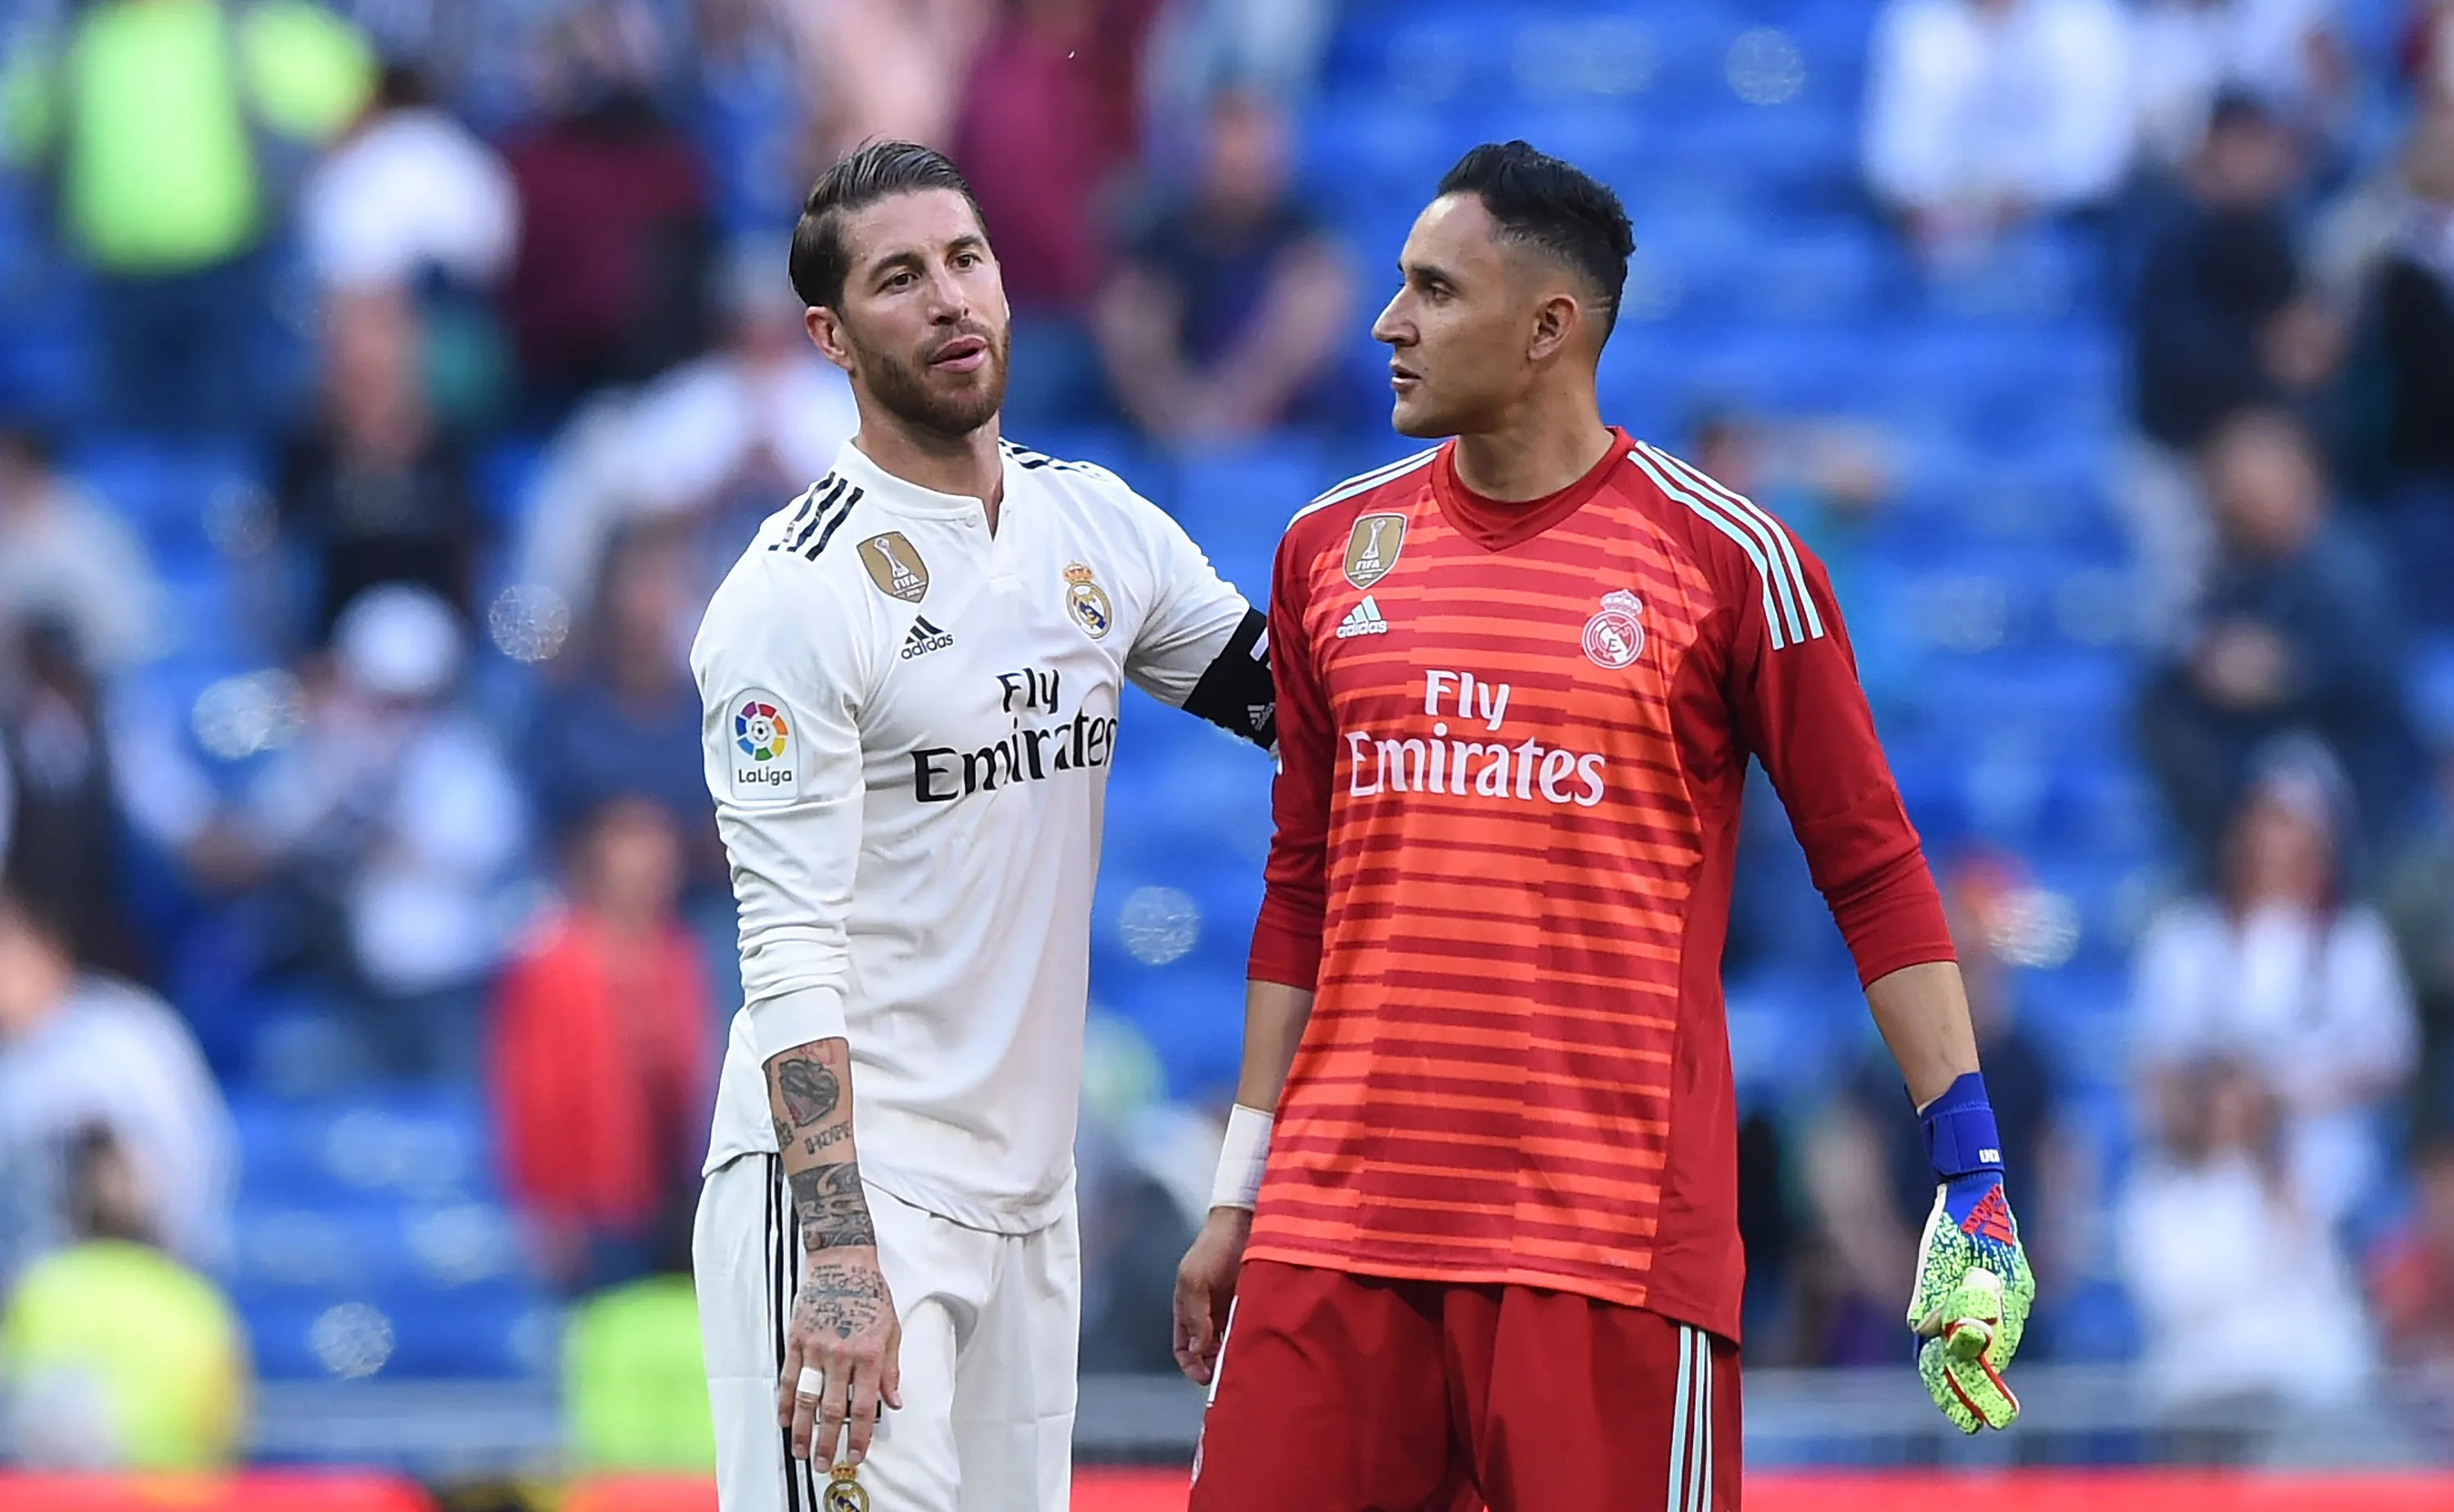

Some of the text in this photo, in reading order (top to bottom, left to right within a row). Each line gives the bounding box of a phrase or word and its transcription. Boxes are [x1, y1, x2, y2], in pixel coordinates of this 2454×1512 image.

[1354, 559, 1381, 571] FIFA
[893, 574, 920, 590] FIFA
[1336, 620, 1387, 639] adidas
[901, 634, 954, 660] adidas
[996, 667, 1061, 714] Fly
[1425, 669, 1511, 731] Fly
[738, 765, 792, 786] LaLiga
[1344, 722, 1606, 807] Emirates
